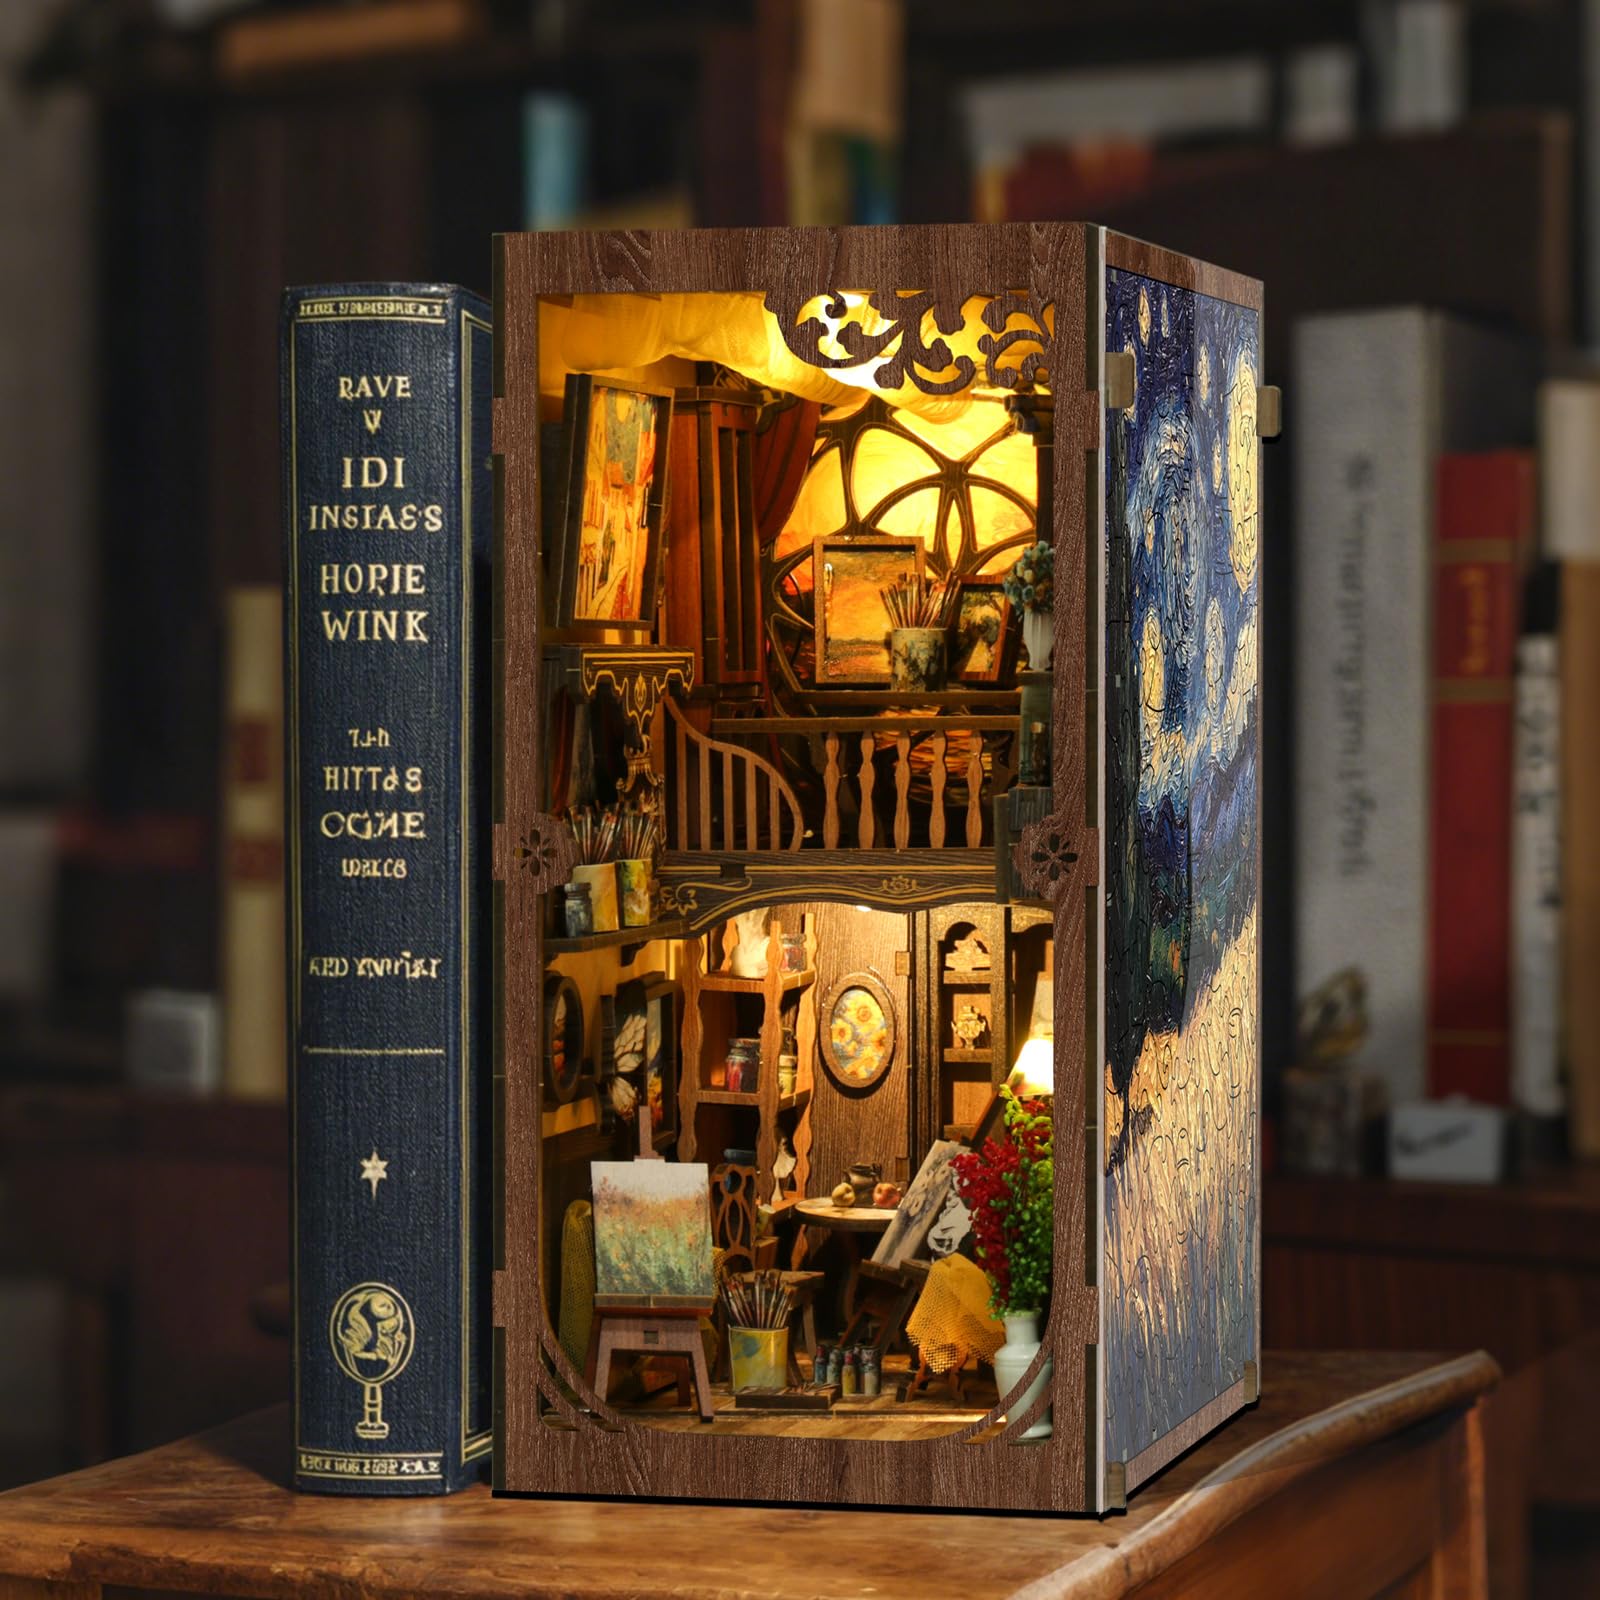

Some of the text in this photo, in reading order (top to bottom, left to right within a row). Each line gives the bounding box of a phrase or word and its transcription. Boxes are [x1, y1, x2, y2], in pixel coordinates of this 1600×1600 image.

[339, 374, 411, 401] RAVE
[341, 456, 405, 489] IDI
[321, 609, 429, 644] WINK
